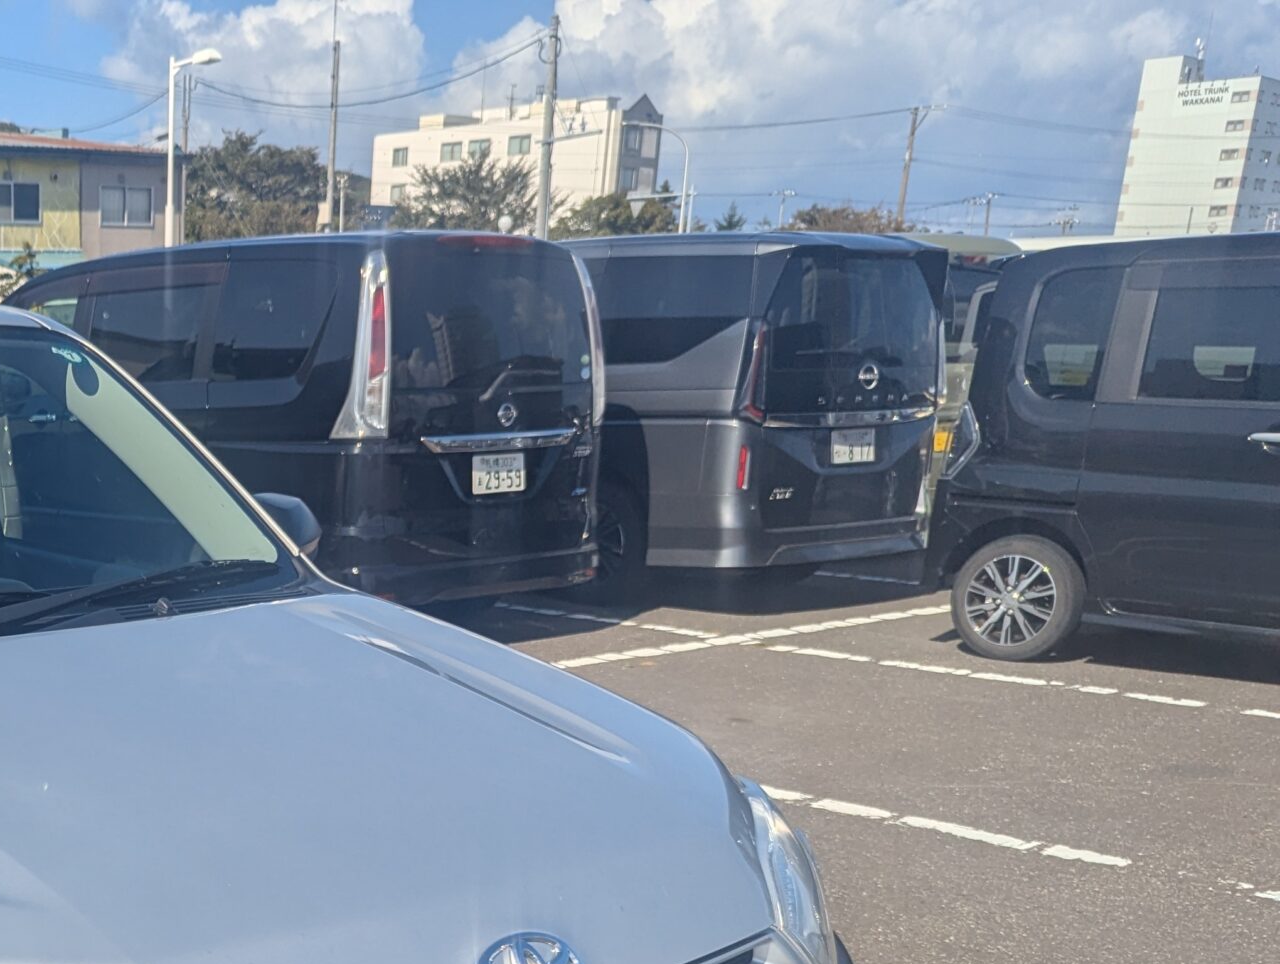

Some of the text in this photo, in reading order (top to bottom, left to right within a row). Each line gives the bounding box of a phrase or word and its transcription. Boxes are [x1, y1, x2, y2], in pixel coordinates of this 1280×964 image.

[1177, 86, 1229, 98] HOTEL TRUNK
[1182, 96, 1223, 106] WAKKANAI
[485, 469, 521, 490] 29-59
